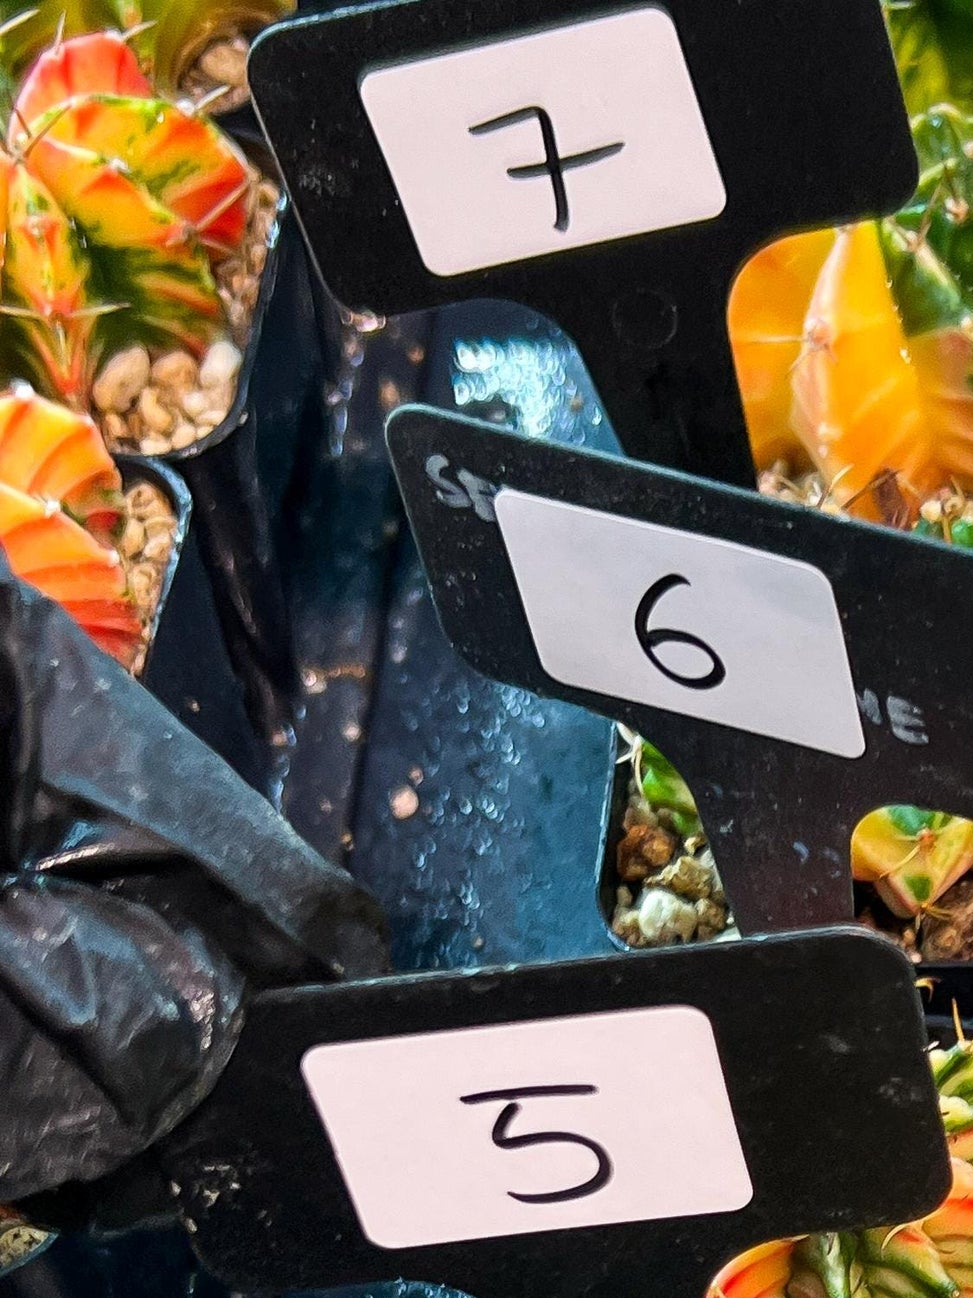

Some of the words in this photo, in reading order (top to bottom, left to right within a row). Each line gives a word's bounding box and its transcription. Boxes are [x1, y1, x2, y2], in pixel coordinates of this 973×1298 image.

[468, 105, 625, 232] 7
[634, 573, 727, 691] 6
[459, 1084, 613, 1204] 5
